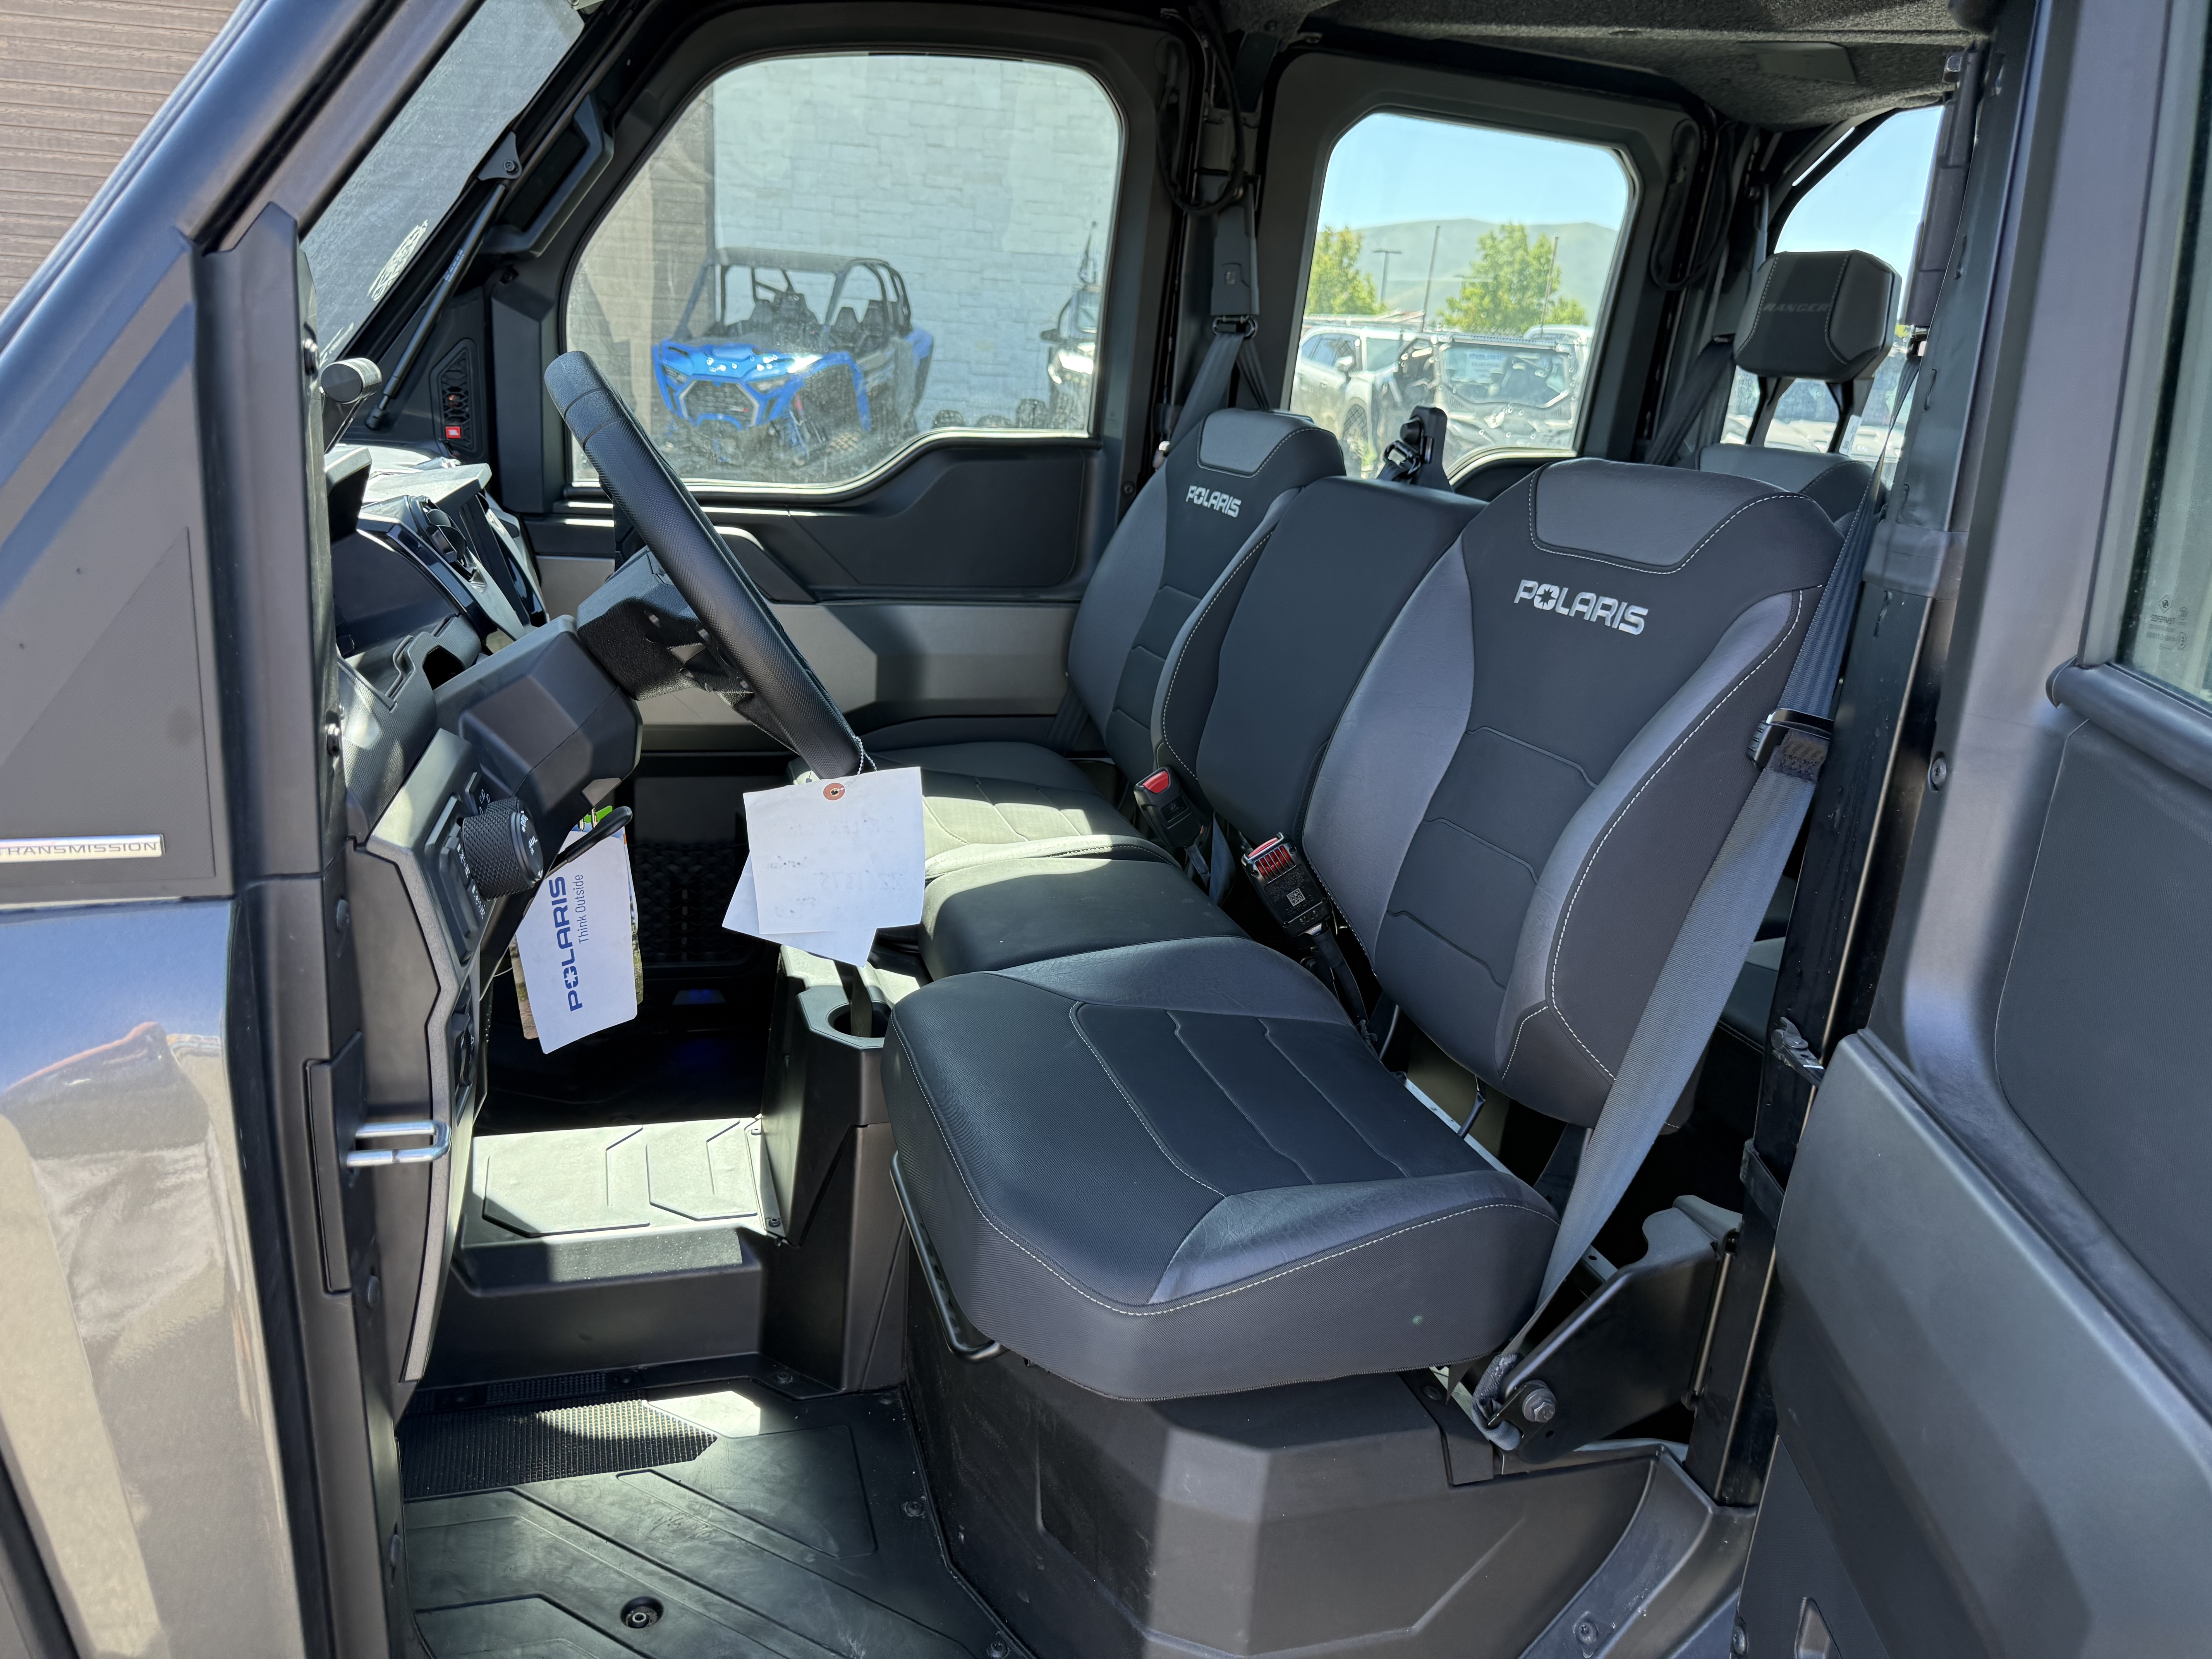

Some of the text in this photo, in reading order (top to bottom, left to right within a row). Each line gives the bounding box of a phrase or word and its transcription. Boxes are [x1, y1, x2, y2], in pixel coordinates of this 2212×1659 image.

[1185, 485, 1242, 518] POLARIS
[1513, 579, 1649, 635] POLARIS
[572, 874, 589, 945] Think Outside
[548, 876, 583, 1012] POLARIS
